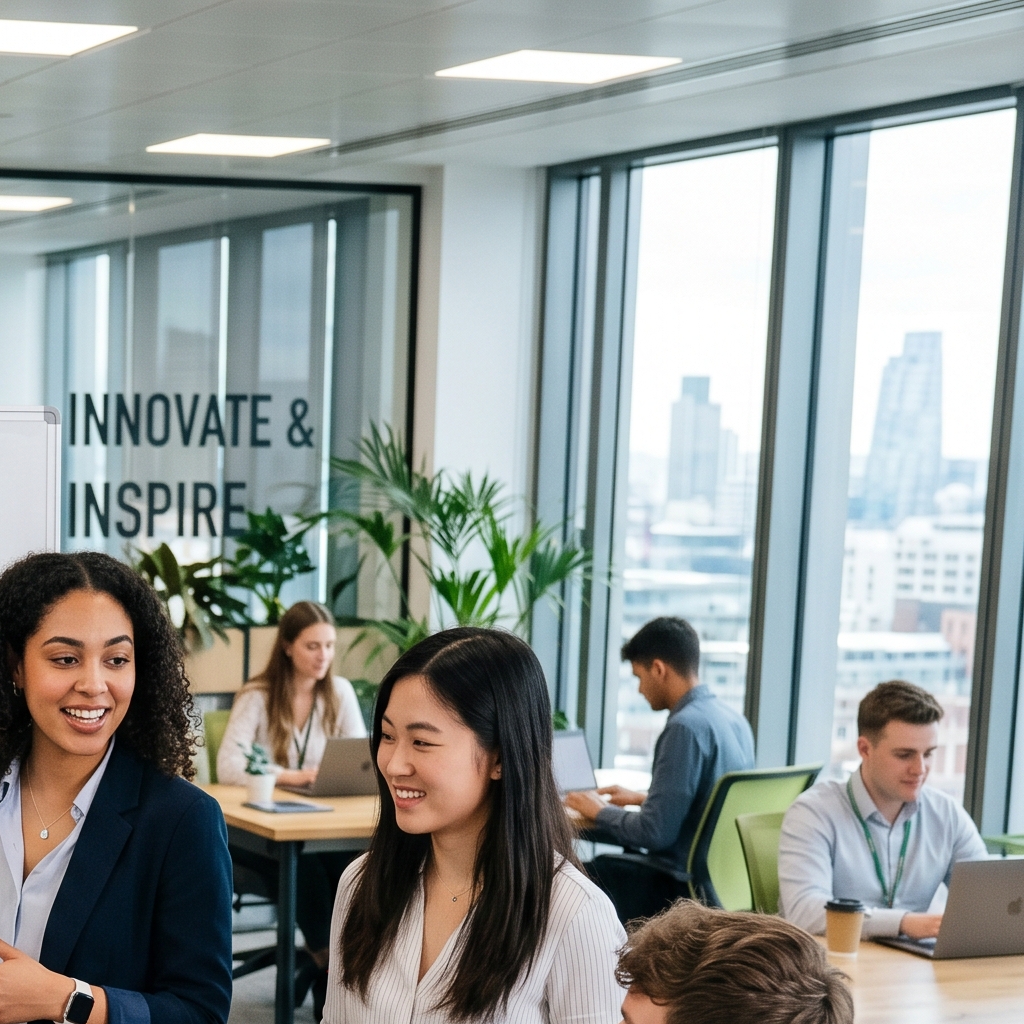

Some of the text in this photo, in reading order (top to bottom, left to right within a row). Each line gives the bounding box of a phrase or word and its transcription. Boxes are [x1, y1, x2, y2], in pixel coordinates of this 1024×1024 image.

[69, 392, 315, 448] INNOVATE &
[69, 481, 246, 538] INSPIRE
